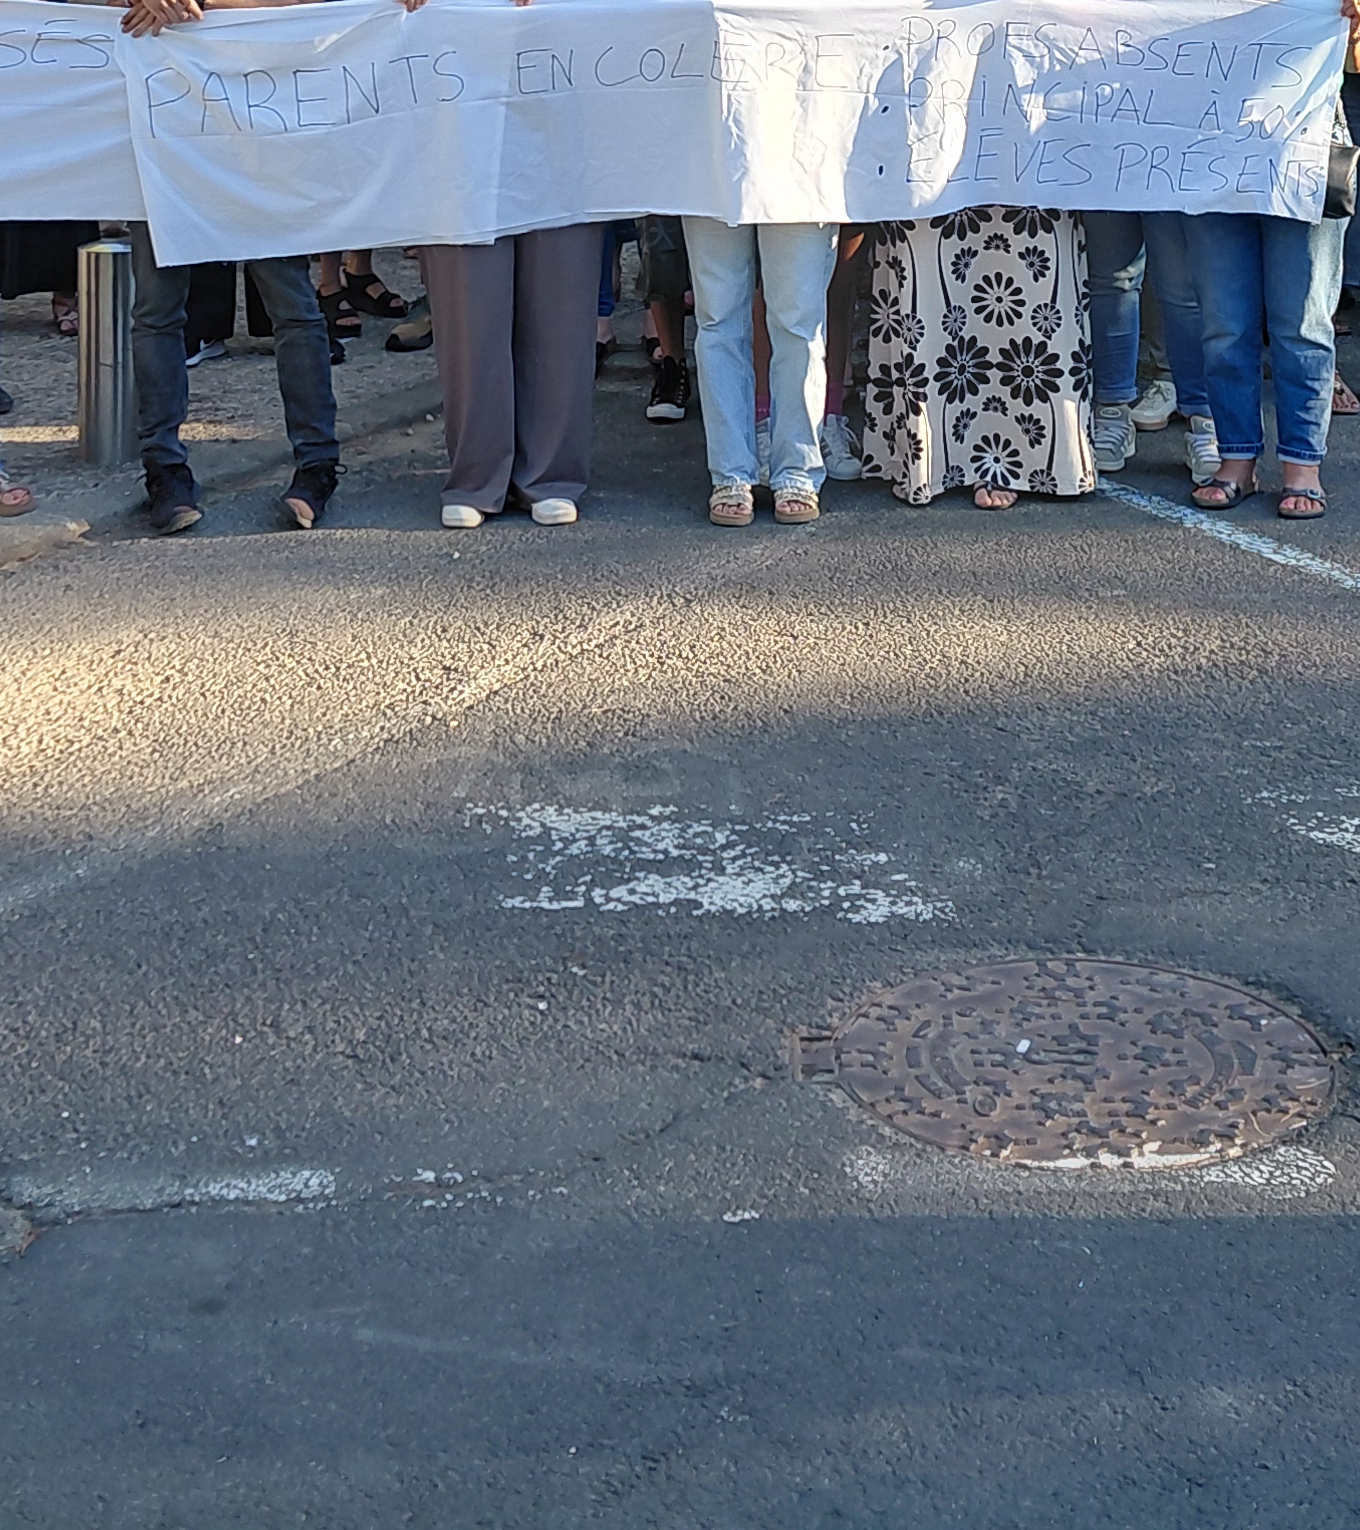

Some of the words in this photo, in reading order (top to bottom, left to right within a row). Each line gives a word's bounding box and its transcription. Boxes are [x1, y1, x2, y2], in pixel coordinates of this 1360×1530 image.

[901, 16, 1057, 69] PROFS
[1069, 26, 1313, 88] ABSENTS
[145, 51, 464, 138] PARENTS
[516, 49, 574, 94] EN
